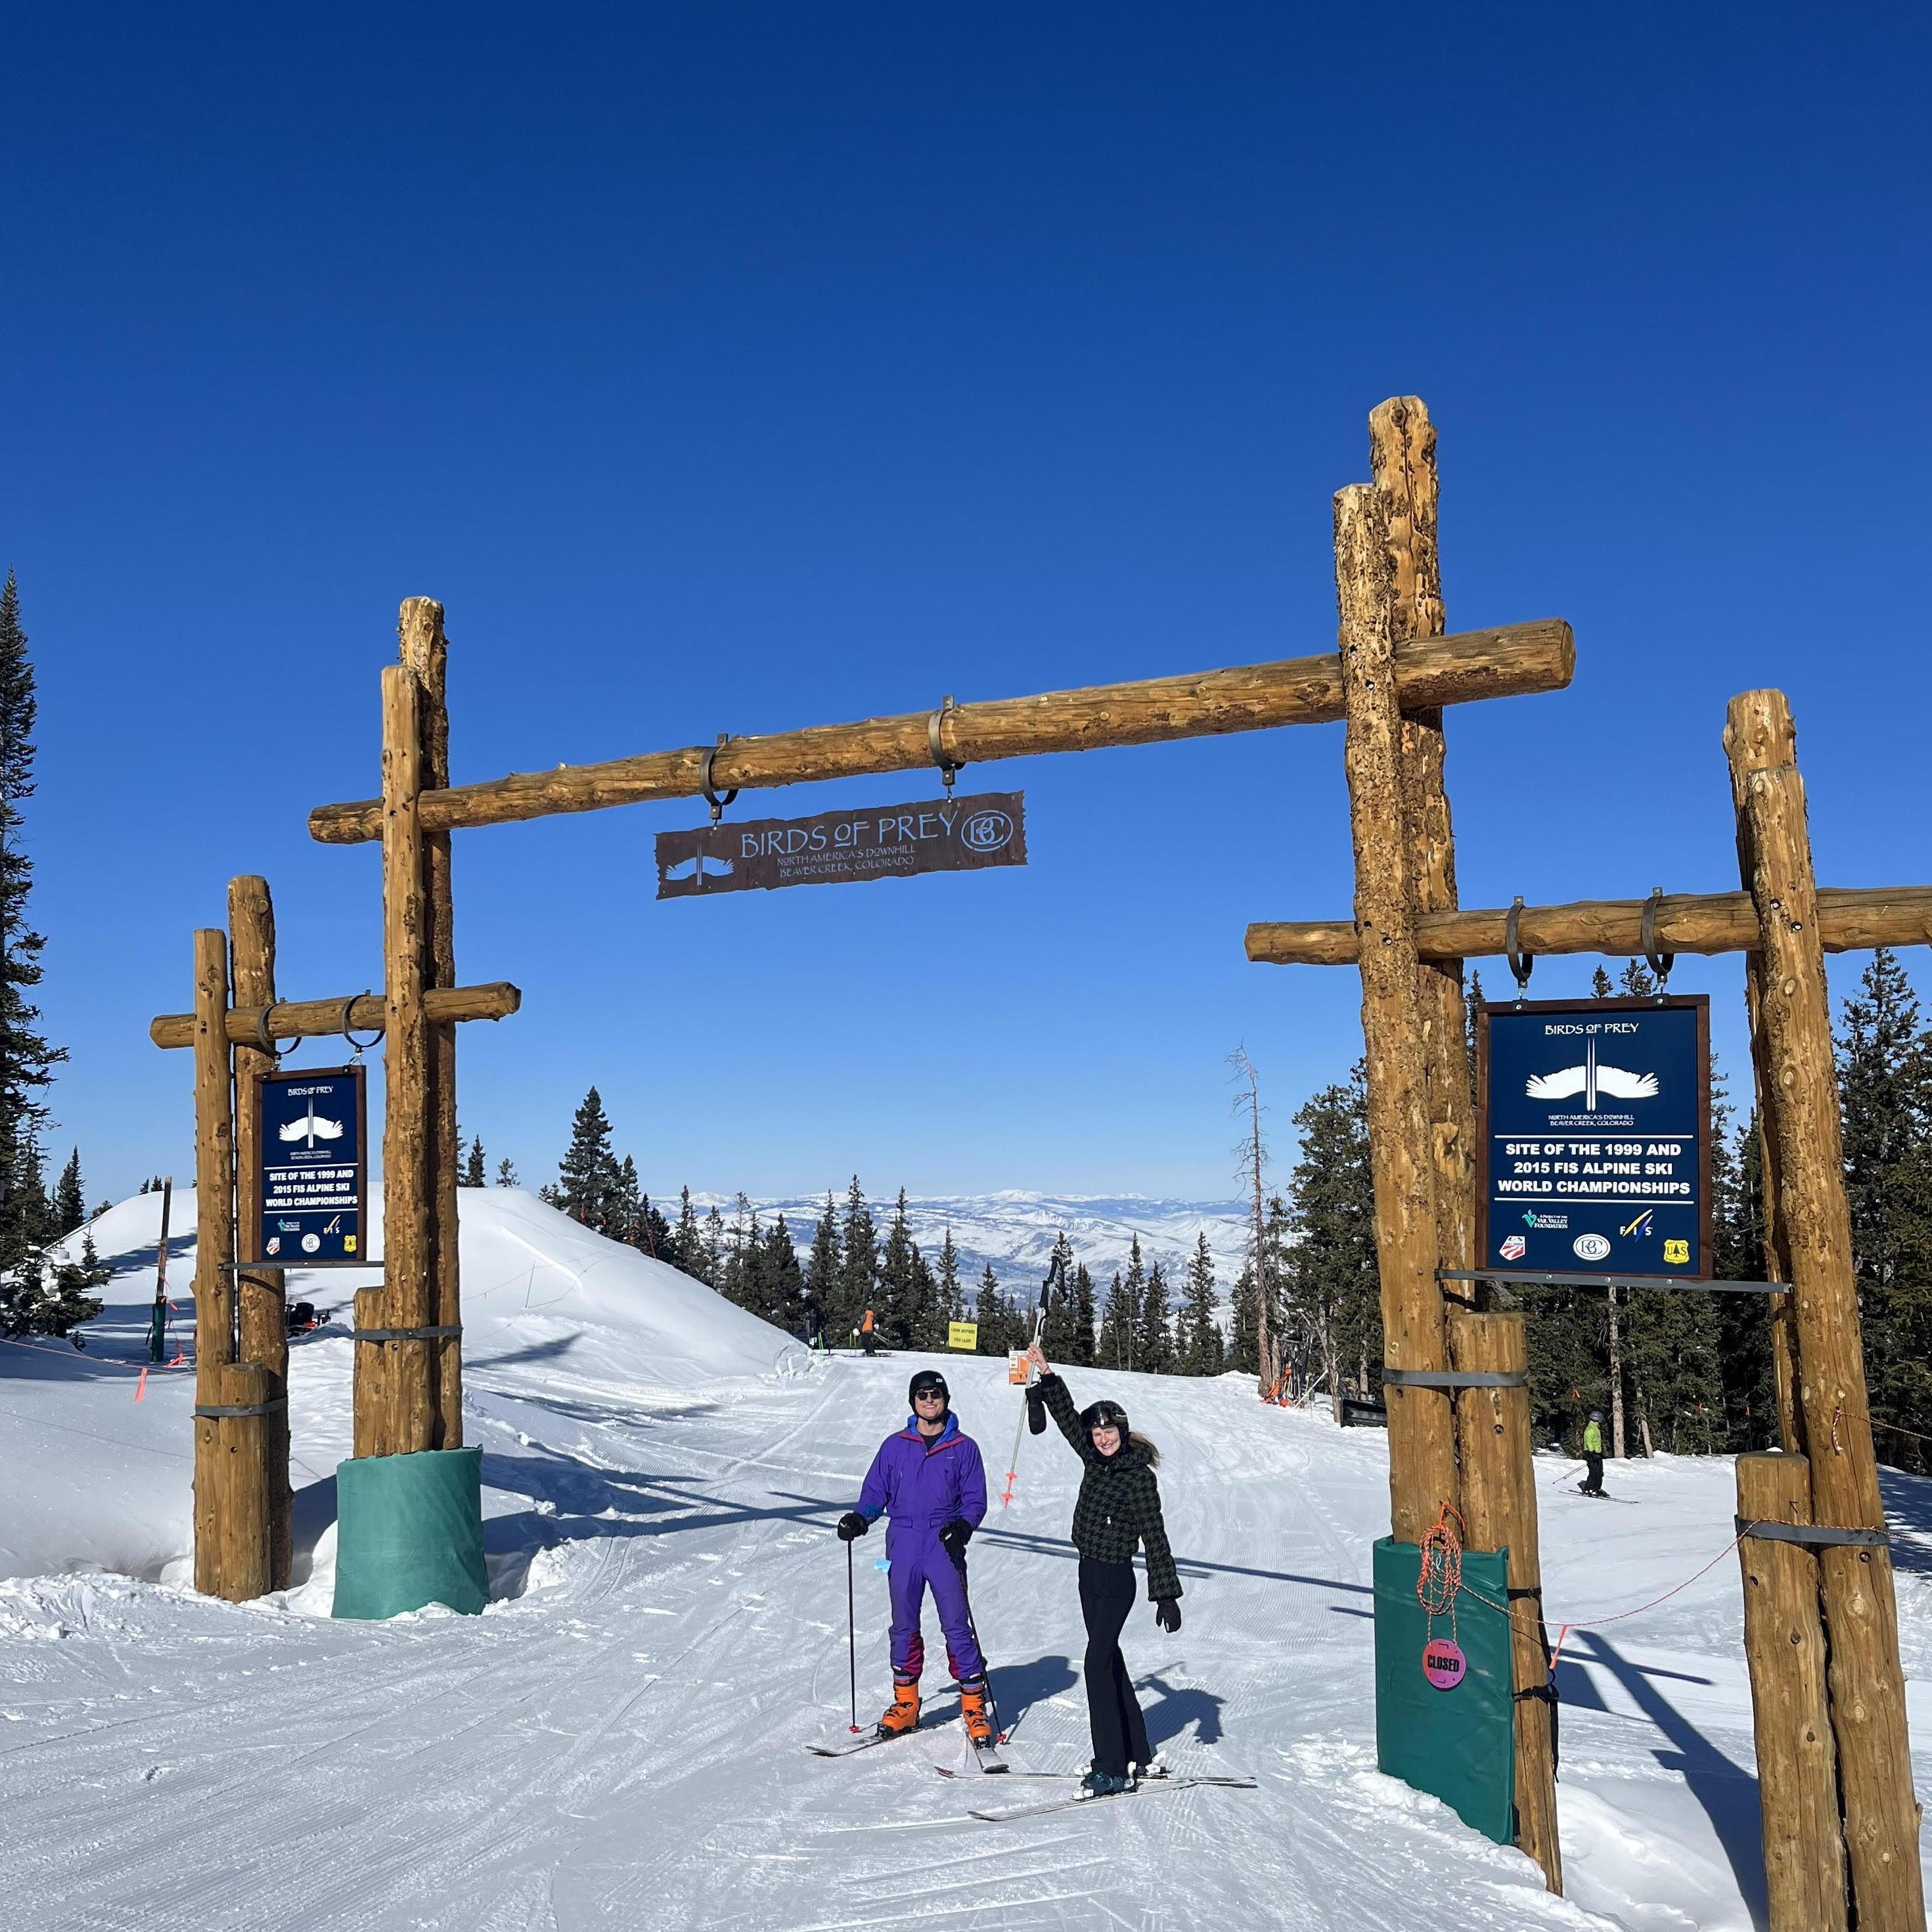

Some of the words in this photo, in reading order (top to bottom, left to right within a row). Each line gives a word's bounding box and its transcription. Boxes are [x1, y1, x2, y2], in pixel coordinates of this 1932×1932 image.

[740, 826, 826, 859] BIRDS
[834, 820, 870, 848] OF
[878, 811, 959, 844] PREY
[777, 855, 809, 866] NORTH
[810, 849, 864, 863] AMERICA'S
[866, 844, 916, 858] DOWNHILL
[780, 866, 819, 878] BEAVER
[818, 863, 853, 874] CREEK,
[855, 856, 914, 870] COLORADO
[1544, 1024, 1584, 1035] BIRDS
[1585, 1023, 1602, 1034] OF
[1605, 1023, 1640, 1033] PREY
[288, 1088, 307, 1096] BIRDS
[1506, 1144, 1540, 1155] SITE
[1544, 1144, 1565, 1156] OF
[1568, 1144, 1601, 1155] THE
[1605, 1144, 1642, 1156] 1999
[1647, 1144, 1682, 1156] AND
[1514, 1162, 1550, 1174] 2015
[1554, 1162, 1579, 1174] FIS
[1583, 1163, 1641, 1175] ALPINE
[1644, 1163, 1673, 1175] SKI
[269, 1173, 287, 1181] SITE
[288, 1172, 299, 1180] OF
[300, 1171, 316, 1180] THE
[317, 1171, 336, 1179] 1999
[336, 1170, 354, 1179] AND
[273, 1185, 292, 1194] 2015
[292, 1184, 305, 1193] FIS
[306, 1184, 335, 1192] ALPINE
[336, 1182, 350, 1192] SKI
[1498, 1180, 1552, 1192] WORLD
[1556, 1181, 1690, 1194] CHAMPIONSHIPS
[265, 1198, 293, 1207] WORLD
[294, 1196, 358, 1206] CHAMPIONSHIPS
[1427, 1654, 1460, 1673] CLOSED
